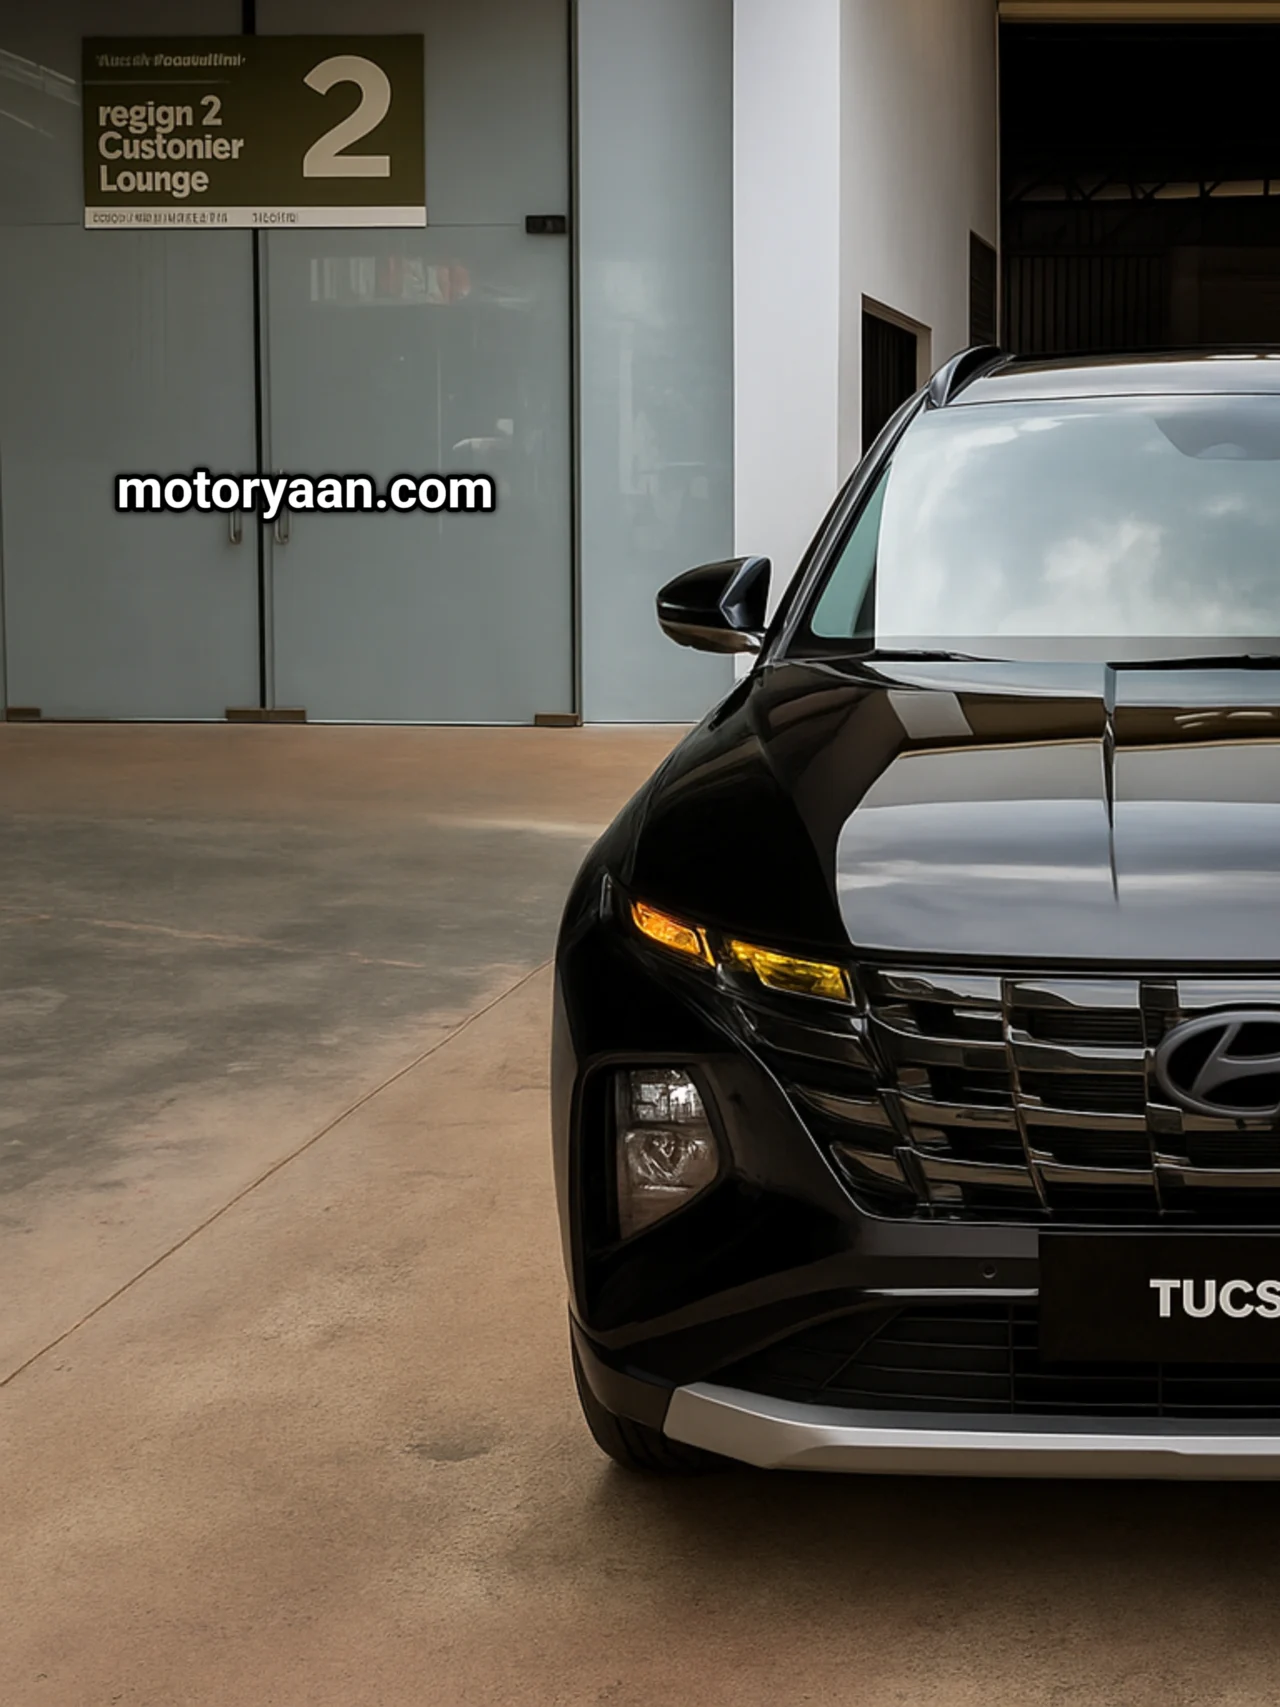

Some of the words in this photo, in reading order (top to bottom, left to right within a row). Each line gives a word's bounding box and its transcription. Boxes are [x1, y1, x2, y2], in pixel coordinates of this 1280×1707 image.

[200, 94, 223, 126] 2
[303, 54, 391, 178] 2
[99, 164, 209, 198] Lounge
